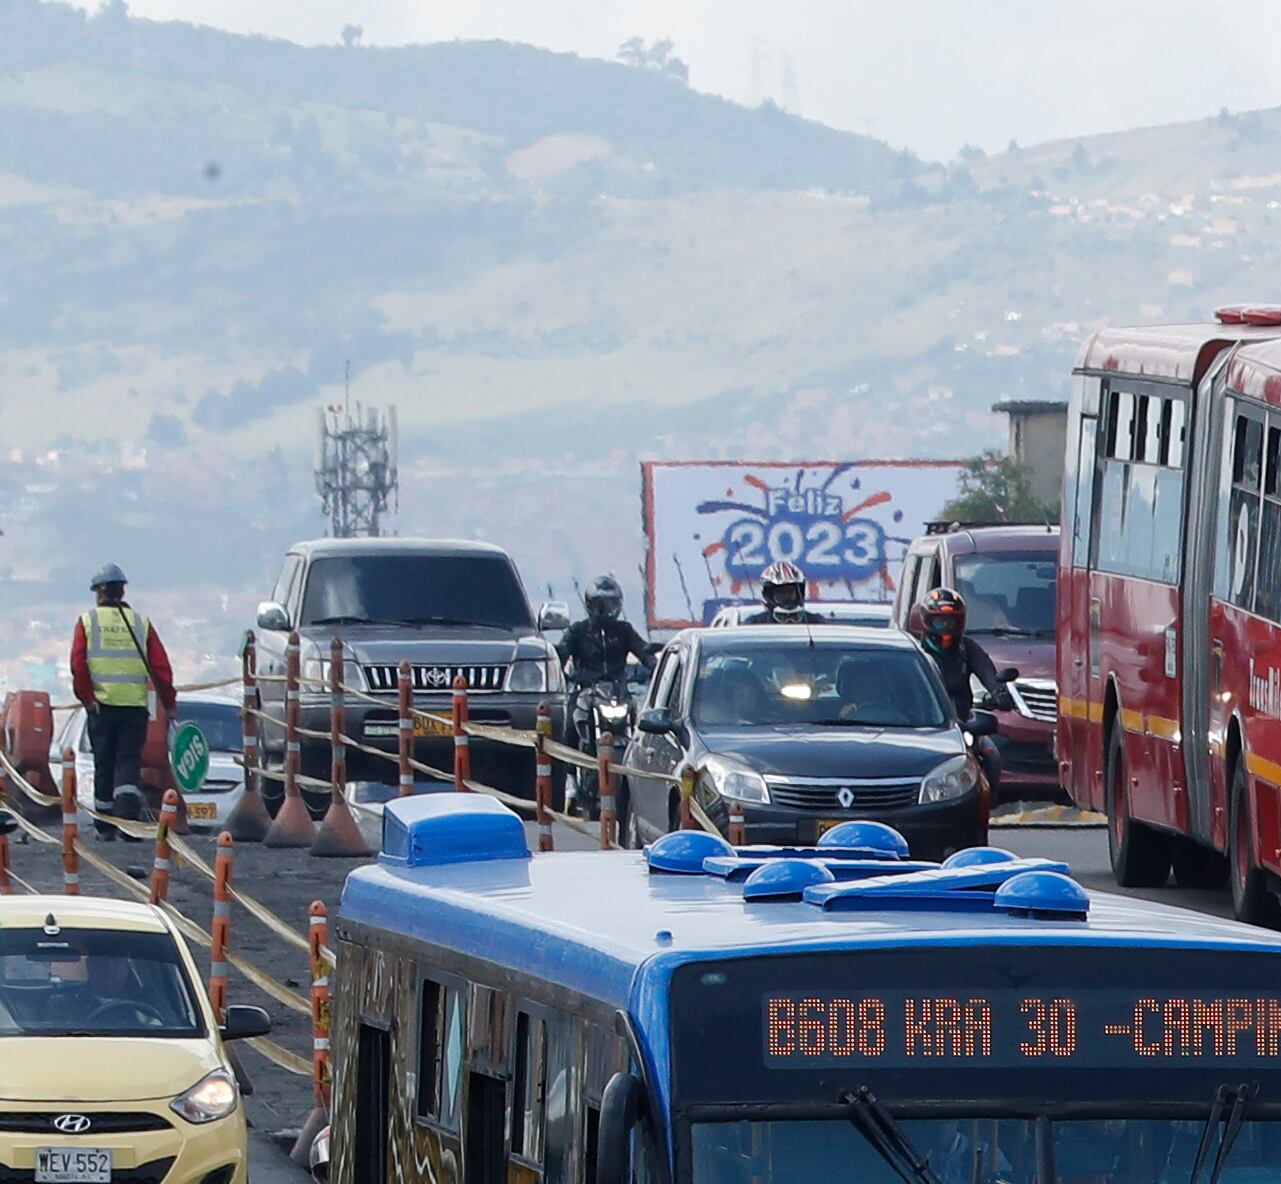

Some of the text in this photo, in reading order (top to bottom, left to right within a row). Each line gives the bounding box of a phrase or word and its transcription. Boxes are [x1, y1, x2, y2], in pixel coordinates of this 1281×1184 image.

[768, 488, 841, 516] Feliz
[730, 520, 880, 567] 2023
[177, 735, 204, 780] SIGA
[769, 998, 885, 1056] B608
[905, 998, 991, 1056] KRA
[1020, 998, 1076, 1056] 30
